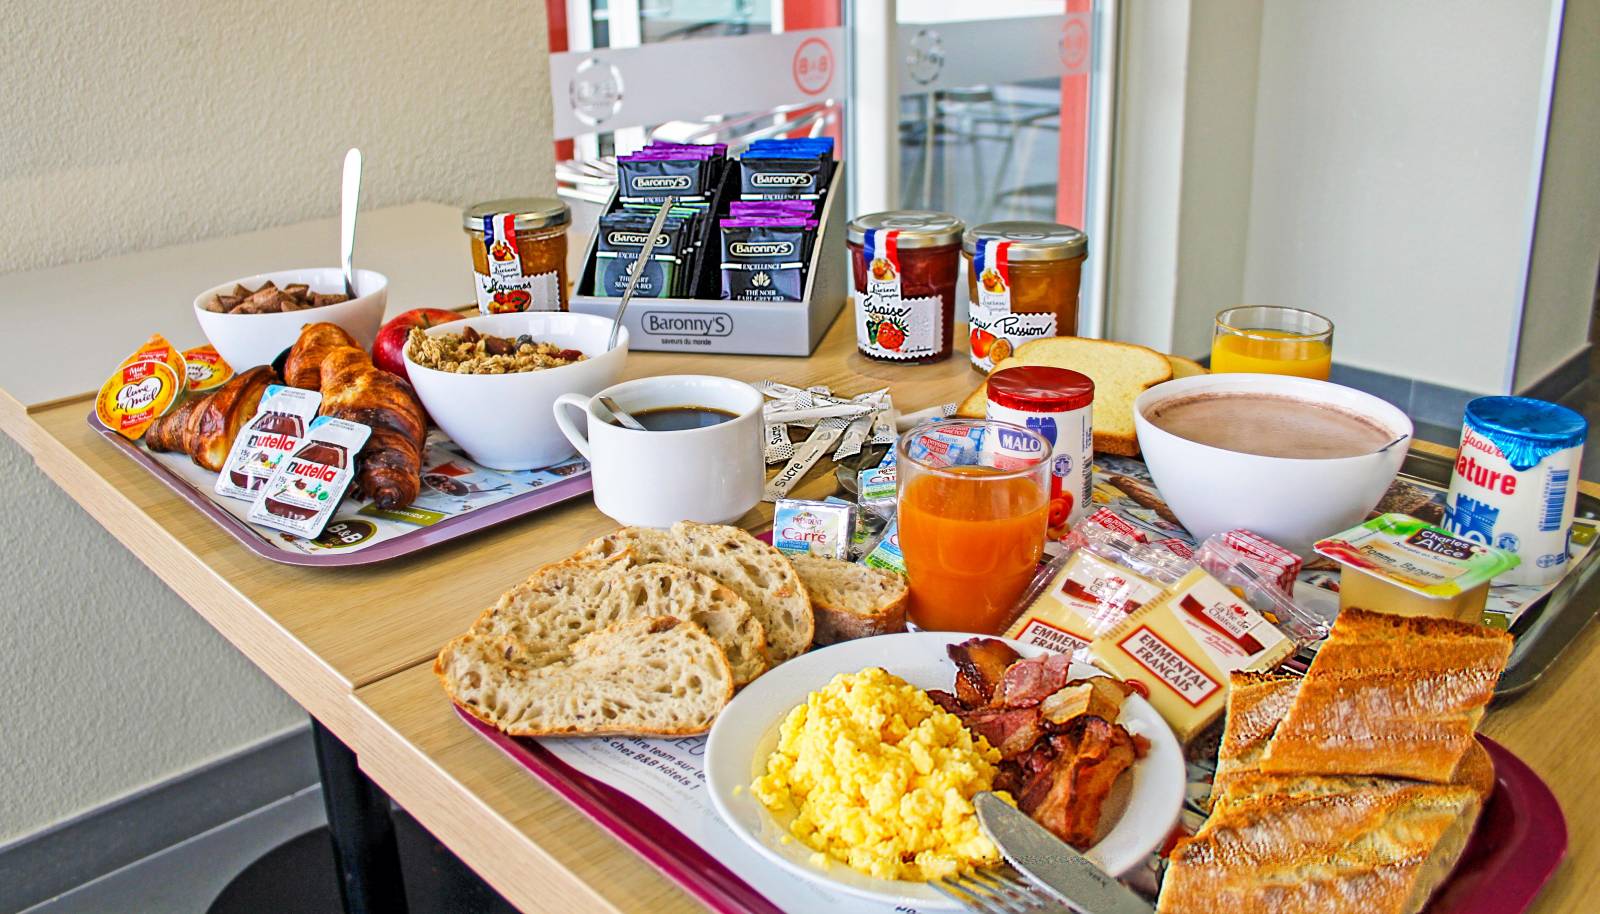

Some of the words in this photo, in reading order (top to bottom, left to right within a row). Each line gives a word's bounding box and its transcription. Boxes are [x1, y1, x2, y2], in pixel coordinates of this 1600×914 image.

[636, 177, 686, 188] Baronny'S
[756, 174, 808, 185] Baronny'S
[736, 243, 789, 254] Baronny'S
[863, 295, 912, 317] Fraise
[649, 315, 725, 335] Baronny'S
[994, 317, 1052, 336] Passion
[247, 434, 296, 452] nutella
[1002, 434, 1041, 451] MALO
[286, 460, 337, 483] nutella
[774, 462, 803, 488] Sucre
[327, 523, 363, 544] B&B
[781, 527, 827, 544] Carré
[1421, 530, 1470, 549] Charles
[1414, 539, 1464, 557] Alice
[1135, 646, 1194, 693] FRANÇAIS
[1139, 634, 1209, 691] EMMENTAL
[610, 741, 635, 757] chez
[633, 752, 659, 767] B&B
[656, 764, 691, 787] Hôtels
[650, 747, 676, 763] team
[675, 758, 695, 772] sur
